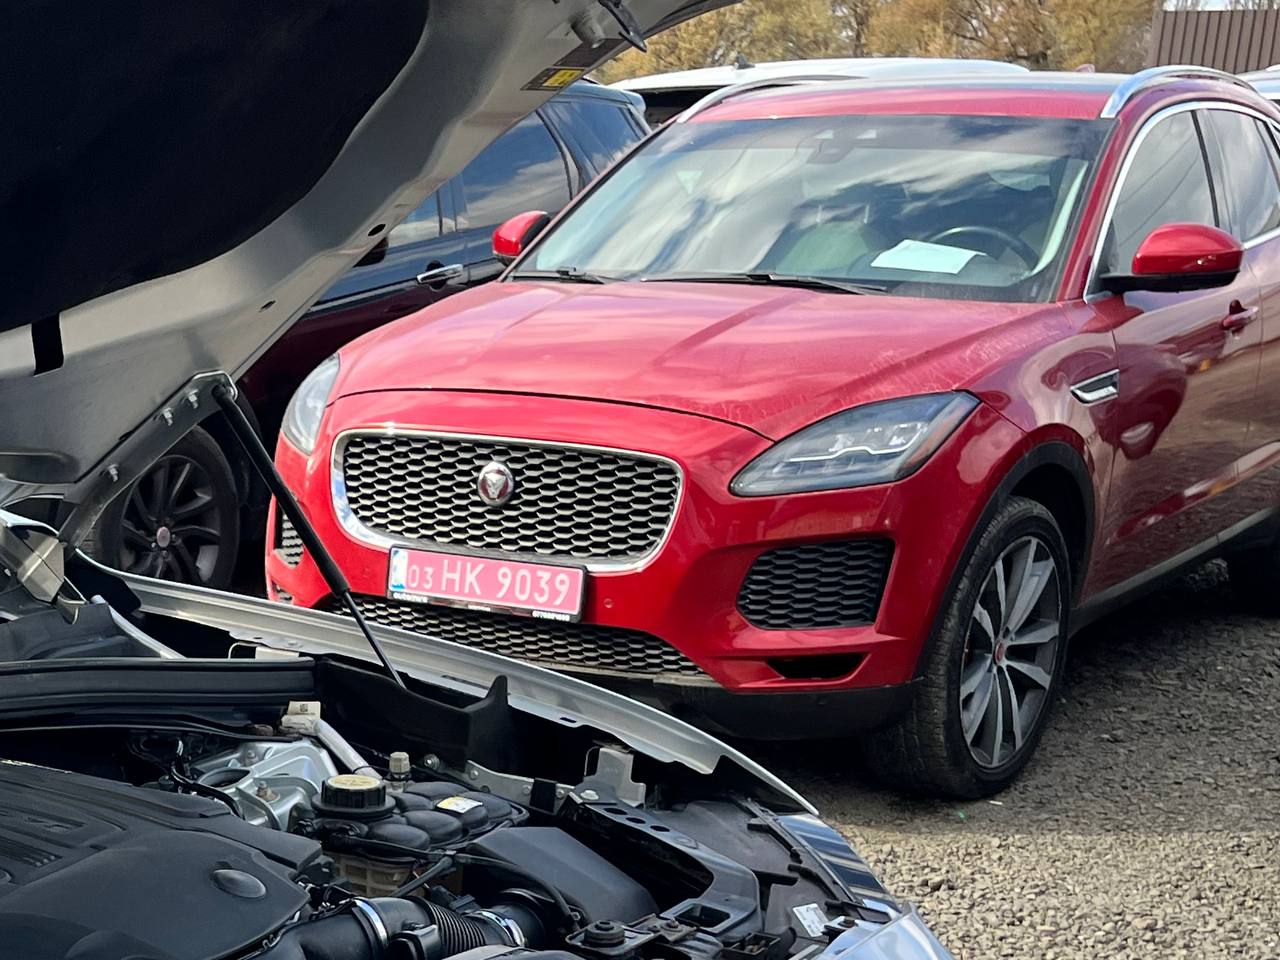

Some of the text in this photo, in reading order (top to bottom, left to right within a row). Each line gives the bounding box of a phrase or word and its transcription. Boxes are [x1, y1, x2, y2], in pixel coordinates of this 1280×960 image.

[408, 558, 570, 606] 03 HK 9039
